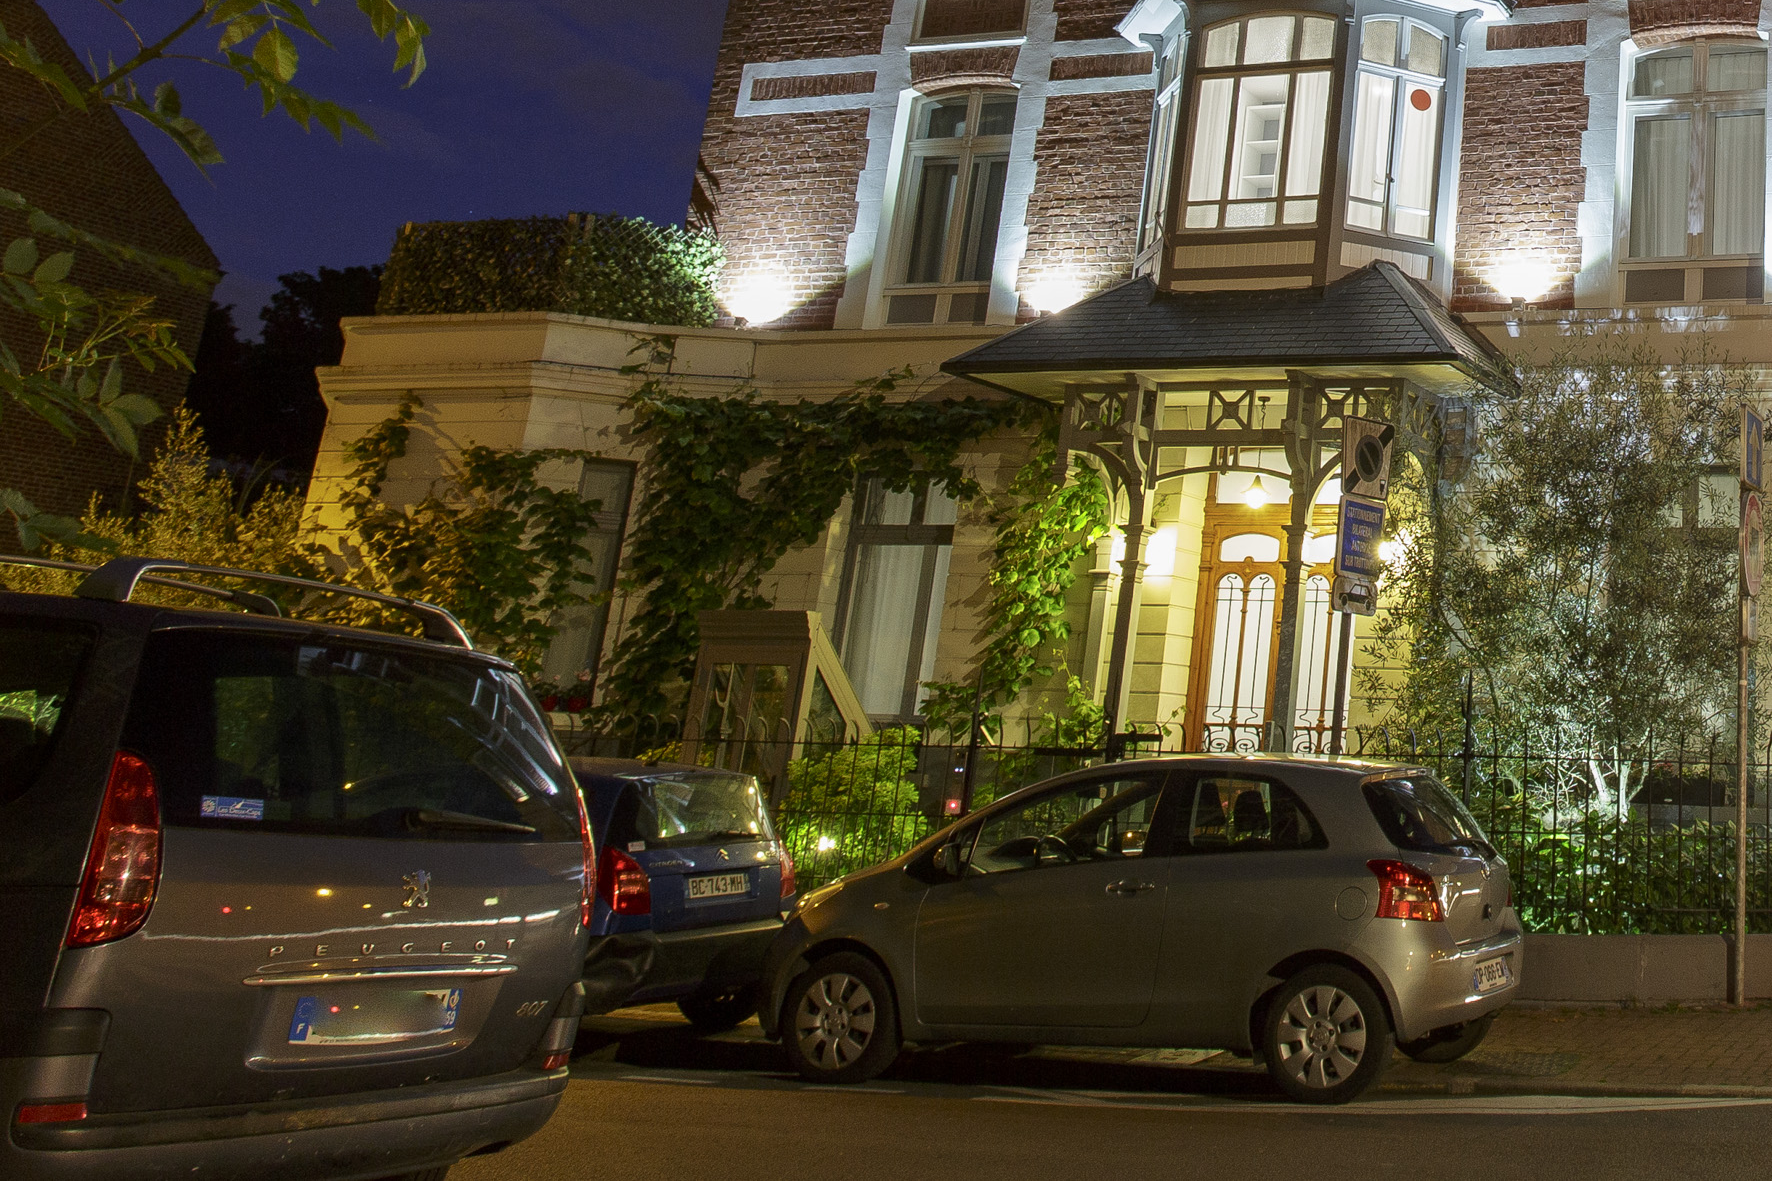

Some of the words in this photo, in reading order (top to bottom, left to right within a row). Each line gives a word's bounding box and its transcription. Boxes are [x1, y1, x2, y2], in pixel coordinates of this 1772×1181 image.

[269, 938, 515, 957] PEUGEOT
[516, 1000, 548, 1017] 807
[296, 1023, 305, 1035] F
